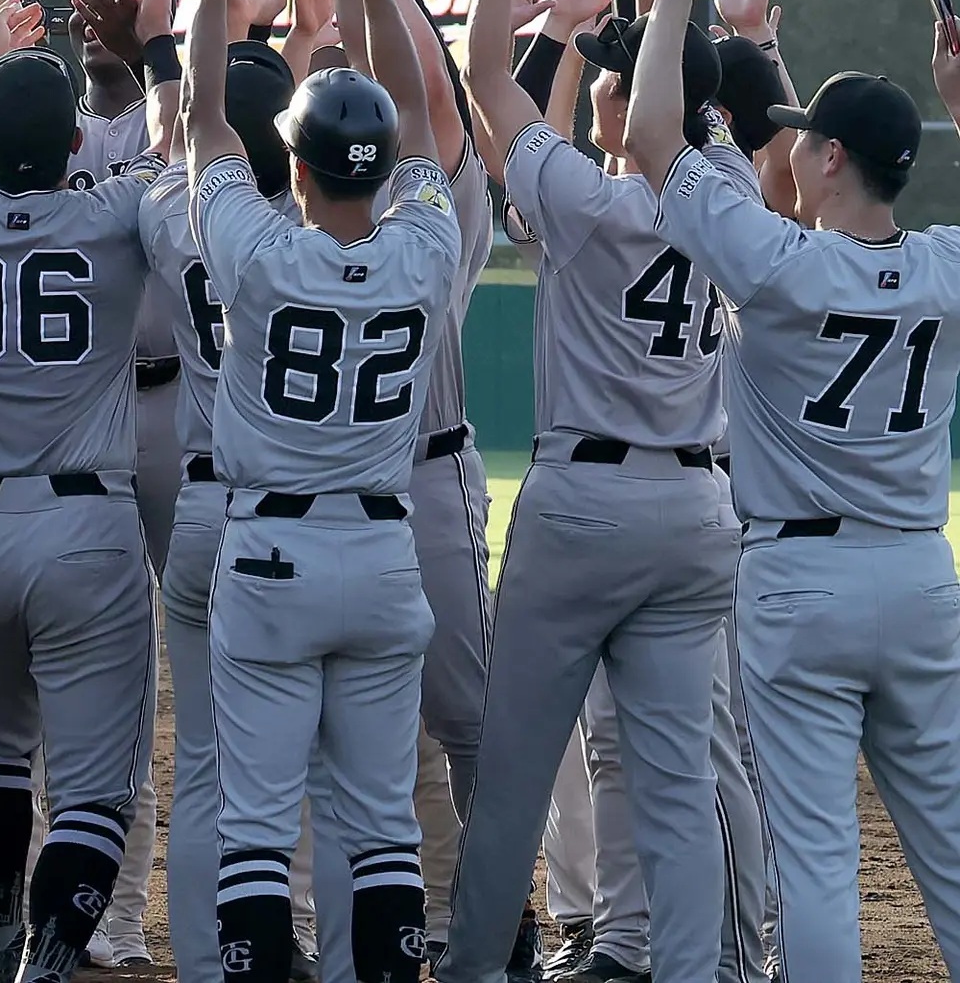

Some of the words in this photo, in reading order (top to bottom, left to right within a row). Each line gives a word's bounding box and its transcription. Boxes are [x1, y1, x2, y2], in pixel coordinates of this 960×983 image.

[348, 144, 377, 162] 82
[261, 302, 429, 424] 82
[799, 311, 943, 434] 71
